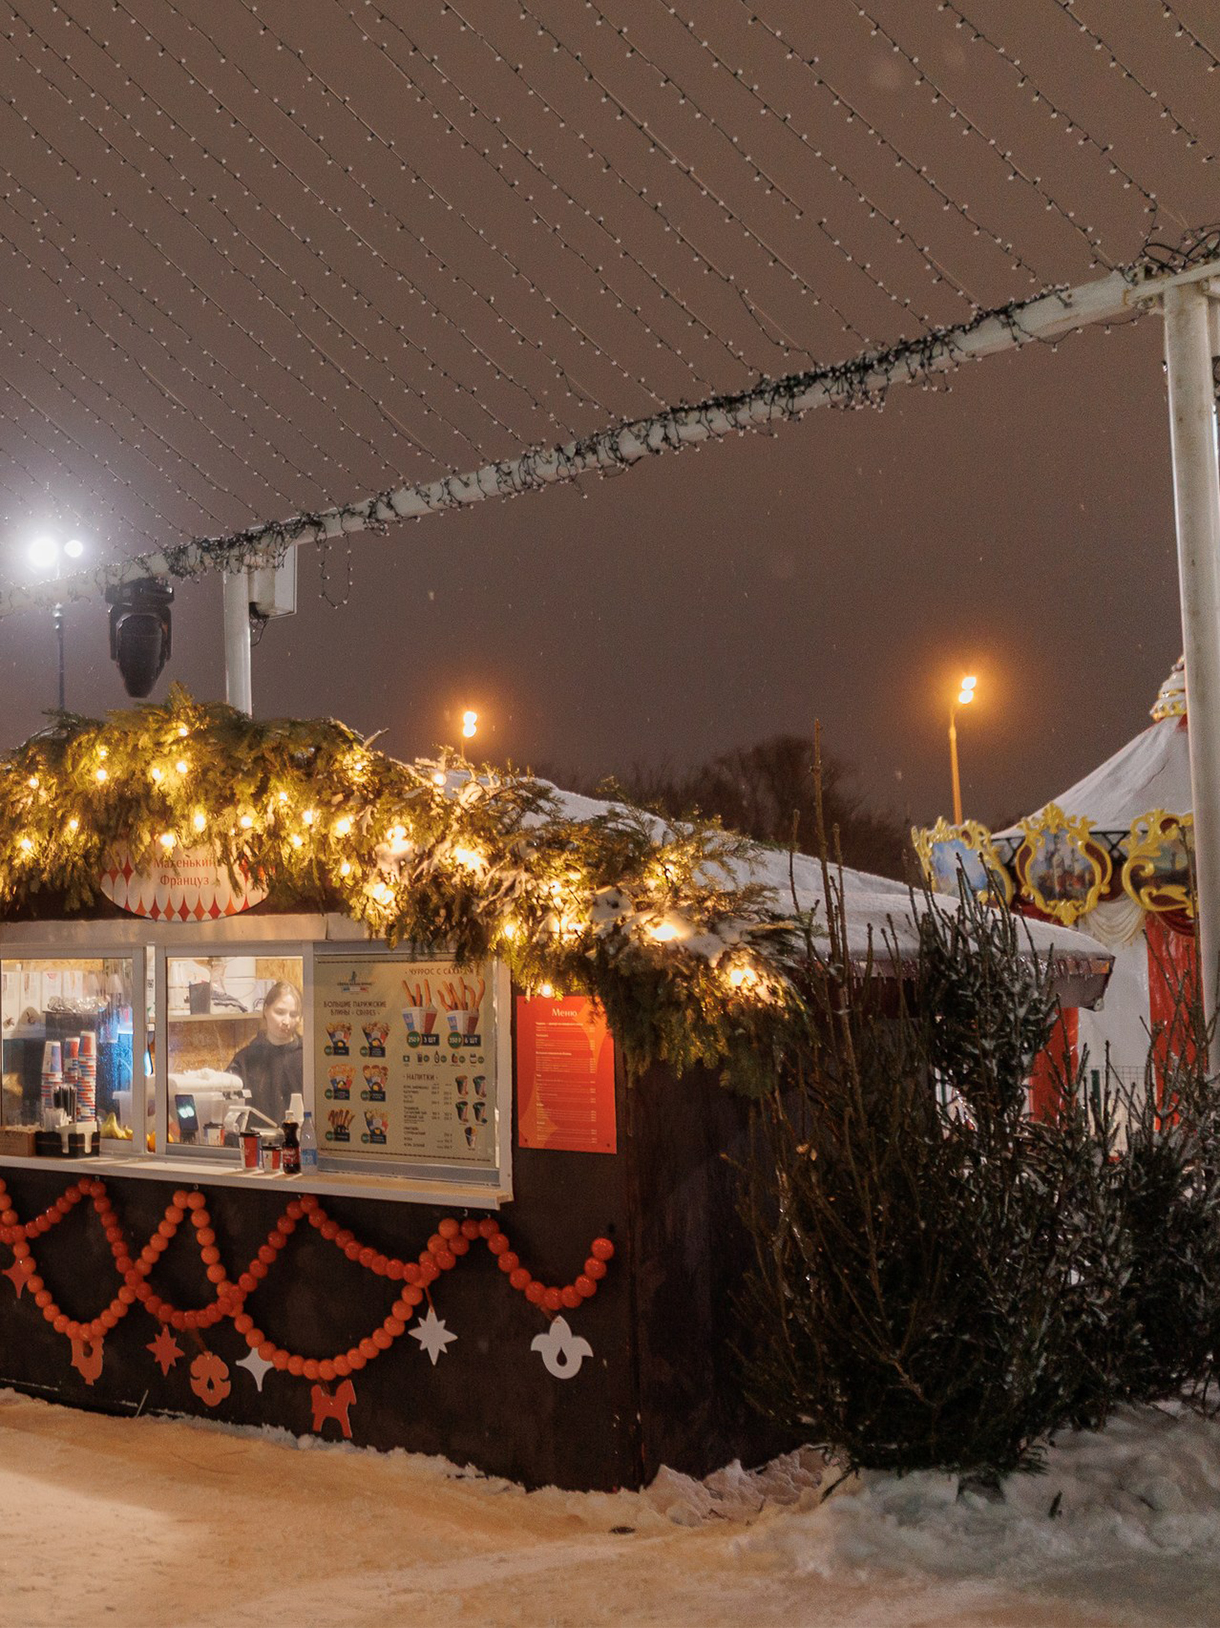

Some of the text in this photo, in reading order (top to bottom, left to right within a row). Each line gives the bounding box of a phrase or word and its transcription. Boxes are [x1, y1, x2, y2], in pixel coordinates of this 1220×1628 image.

[160, 874, 209, 889] Француз
[409, 968, 435, 976] ЧУРРОС
[552, 1008, 578, 1017] Меню
[406, 1073, 435, 1081] НАПИТКИ
